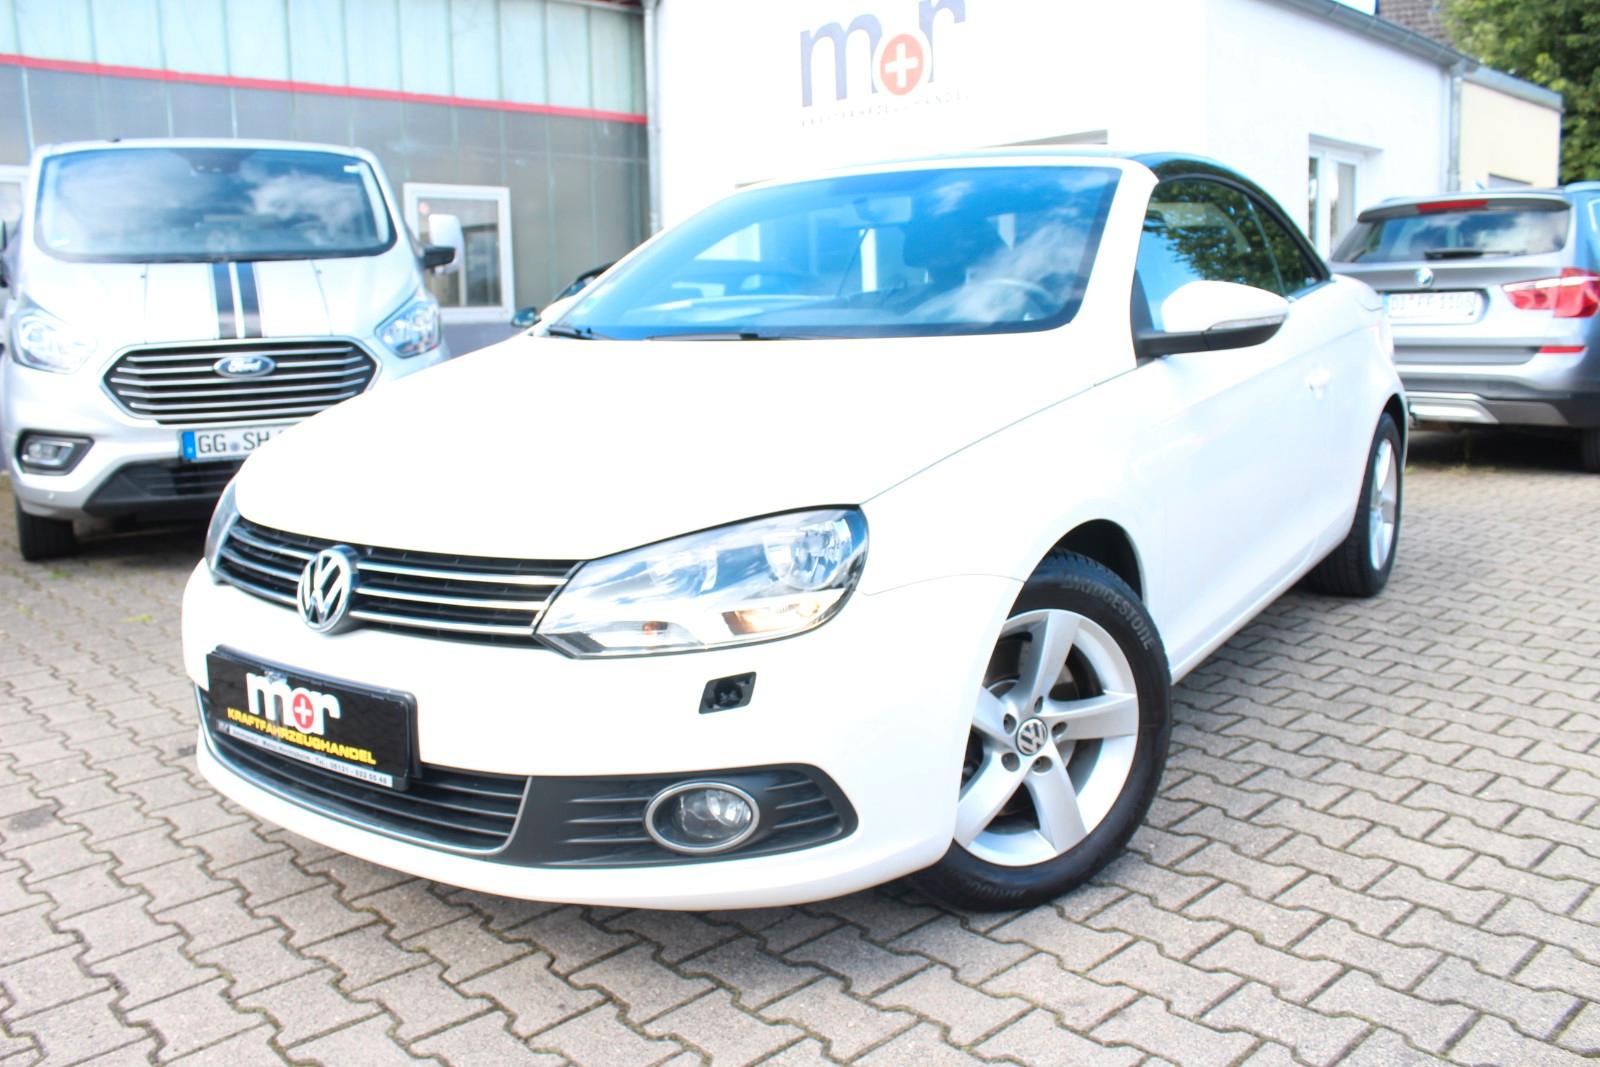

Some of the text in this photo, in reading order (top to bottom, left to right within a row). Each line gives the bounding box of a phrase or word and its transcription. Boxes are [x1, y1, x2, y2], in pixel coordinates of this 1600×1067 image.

[227, 357, 262, 373] Ford
[198, 431, 270, 453] GG SH
[227, 707, 376, 765] KRAFTFAHRZEUGHANDEL
